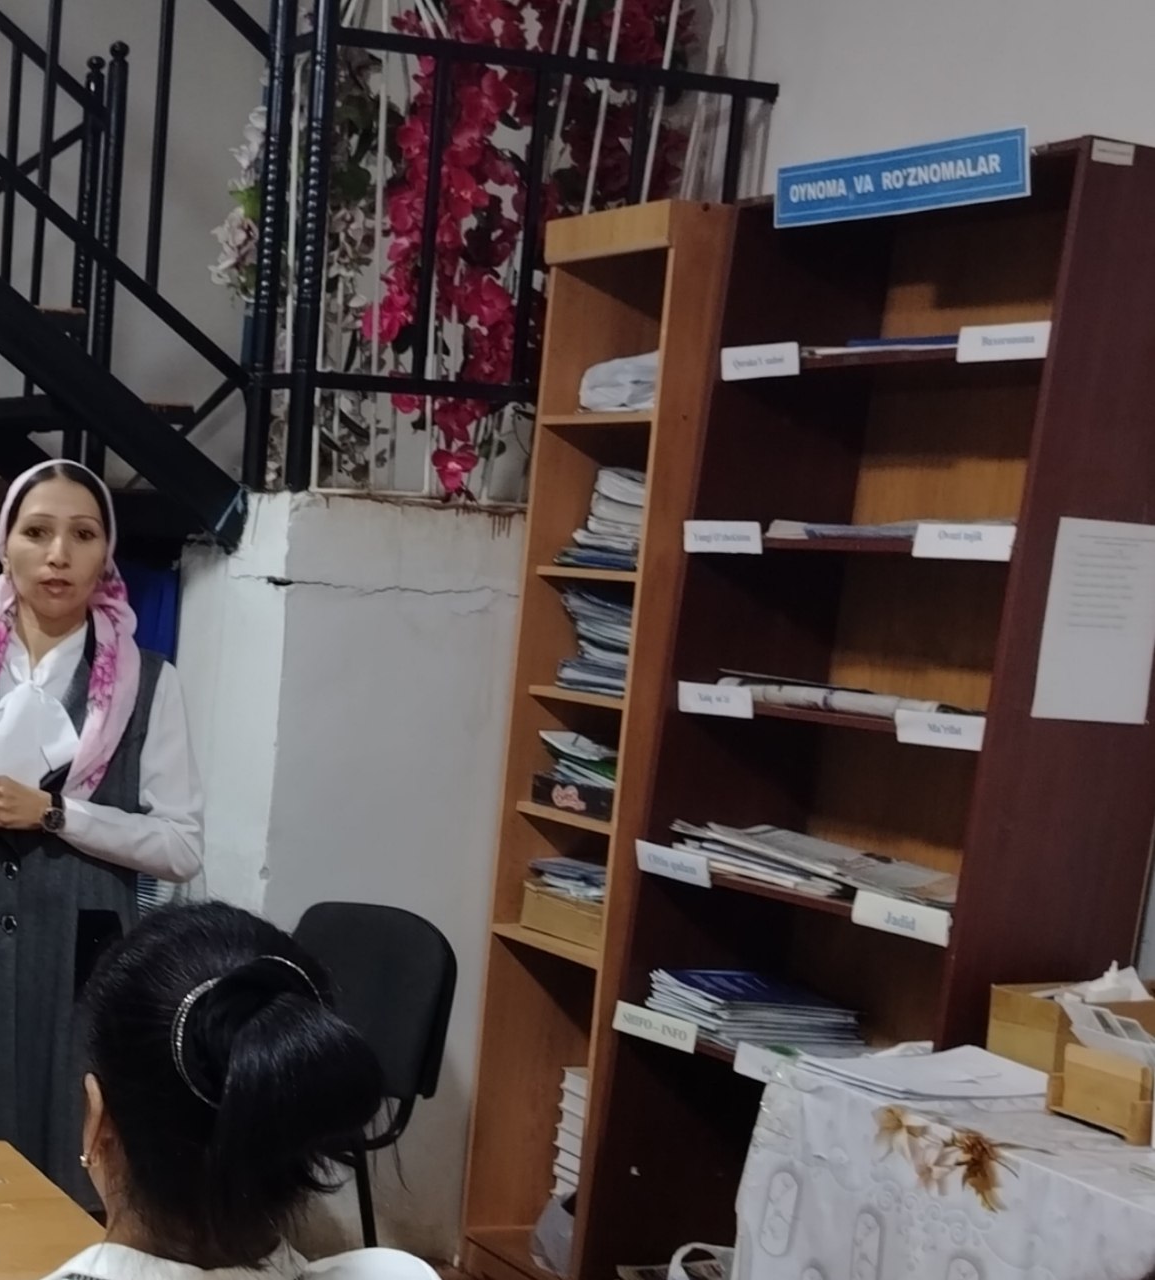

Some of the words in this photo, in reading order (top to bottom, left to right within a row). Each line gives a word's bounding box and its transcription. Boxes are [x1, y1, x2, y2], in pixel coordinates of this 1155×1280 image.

[853, 174, 875, 194] VA
[881, 153, 1002, 190] RO'ZNOMALAR
[660, 1023, 688, 1042] INFO
